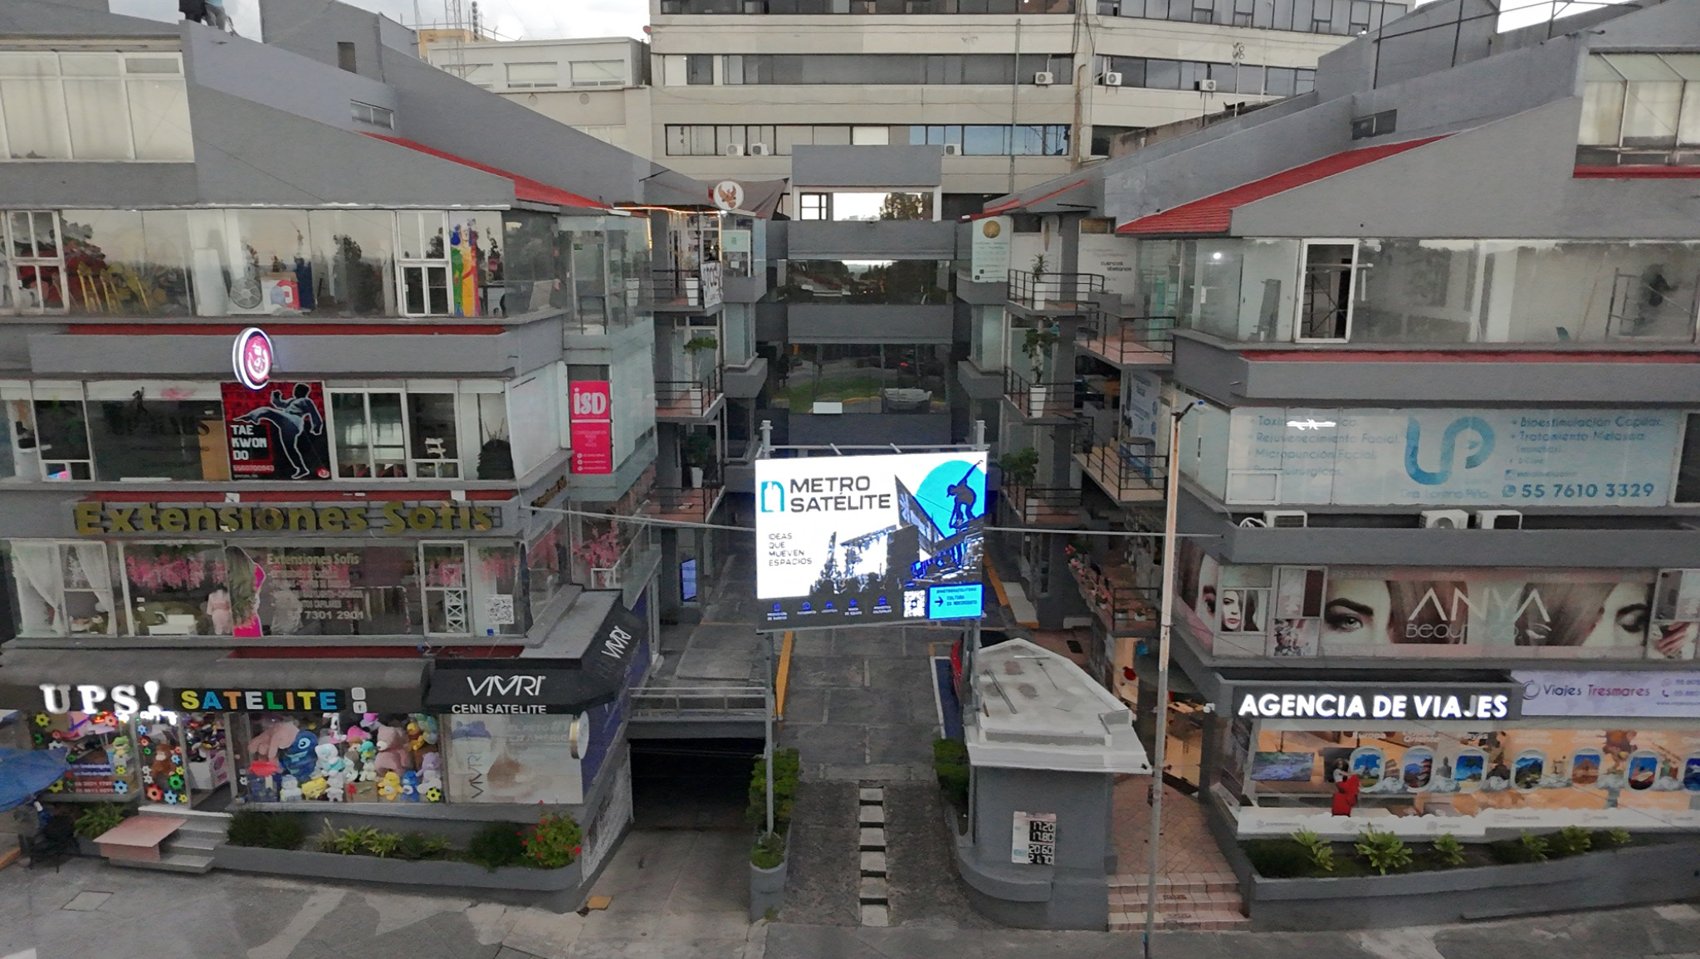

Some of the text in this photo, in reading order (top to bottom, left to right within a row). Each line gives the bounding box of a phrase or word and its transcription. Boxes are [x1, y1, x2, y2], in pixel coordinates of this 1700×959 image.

[230, 425, 254, 435] TAE
[231, 437, 267, 448] KWON
[232, 450, 249, 460] DO
[790, 476, 870, 494] METRO
[1521, 483, 1655, 498] 55 7610 3329
[790, 490, 891, 513] SATÉLITE
[73, 499, 496, 538] Extensiones Sofis
[768, 532, 793, 541] IDEAS
[768, 541, 785, 550] QUE
[266, 553, 360, 565] Extensiones Sofis
[768, 549, 805, 557] MUEVEN
[768, 558, 812, 567] ESPACIOS
[1408, 586, 1551, 623] ANYA
[304, 610, 332, 620] 7301
[336, 610, 364, 620] 2901
[466, 674, 546, 697] VIVRI
[1543, 684, 1651, 697] Viajes Tresmares
[40, 681, 338, 716] UPS! SATELITE
[451, 703, 547, 715] CENI SATELITE
[1238, 694, 1508, 719] AGENCIA DE VIAJES
